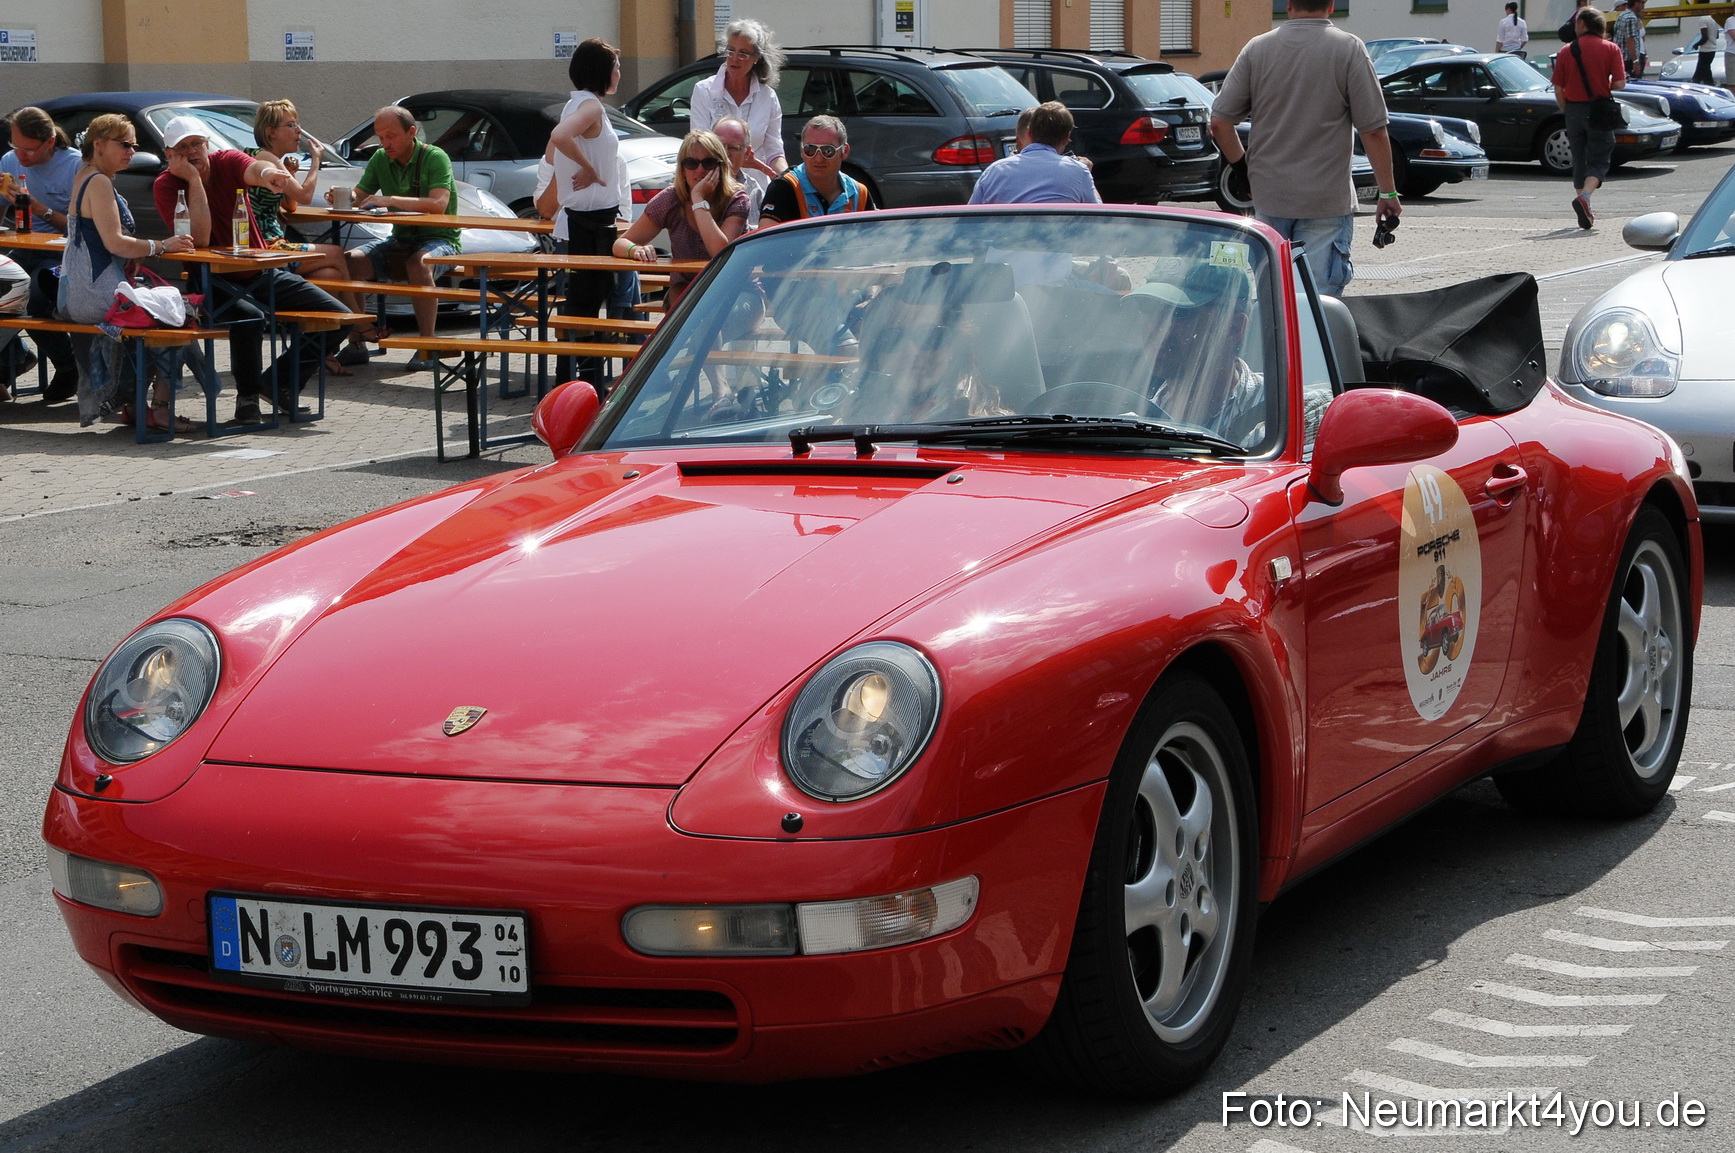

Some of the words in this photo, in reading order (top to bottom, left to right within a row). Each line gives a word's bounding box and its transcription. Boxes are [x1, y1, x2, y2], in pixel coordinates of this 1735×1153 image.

[1, 32, 7, 42] P
[1418, 473, 1442, 523] 49
[1417, 529, 1460, 557] PORSCHE
[1433, 547, 1446, 562] 911
[1430, 664, 1452, 681] JAHRE
[494, 923, 520, 942] 04
[222, 941, 232, 957] D
[238, 906, 272, 966] N
[303, 911, 372, 974] LM
[383, 918, 484, 981] 993
[498, 965, 522, 984] 10
[309, 982, 393, 998] Sportwagen-Service
